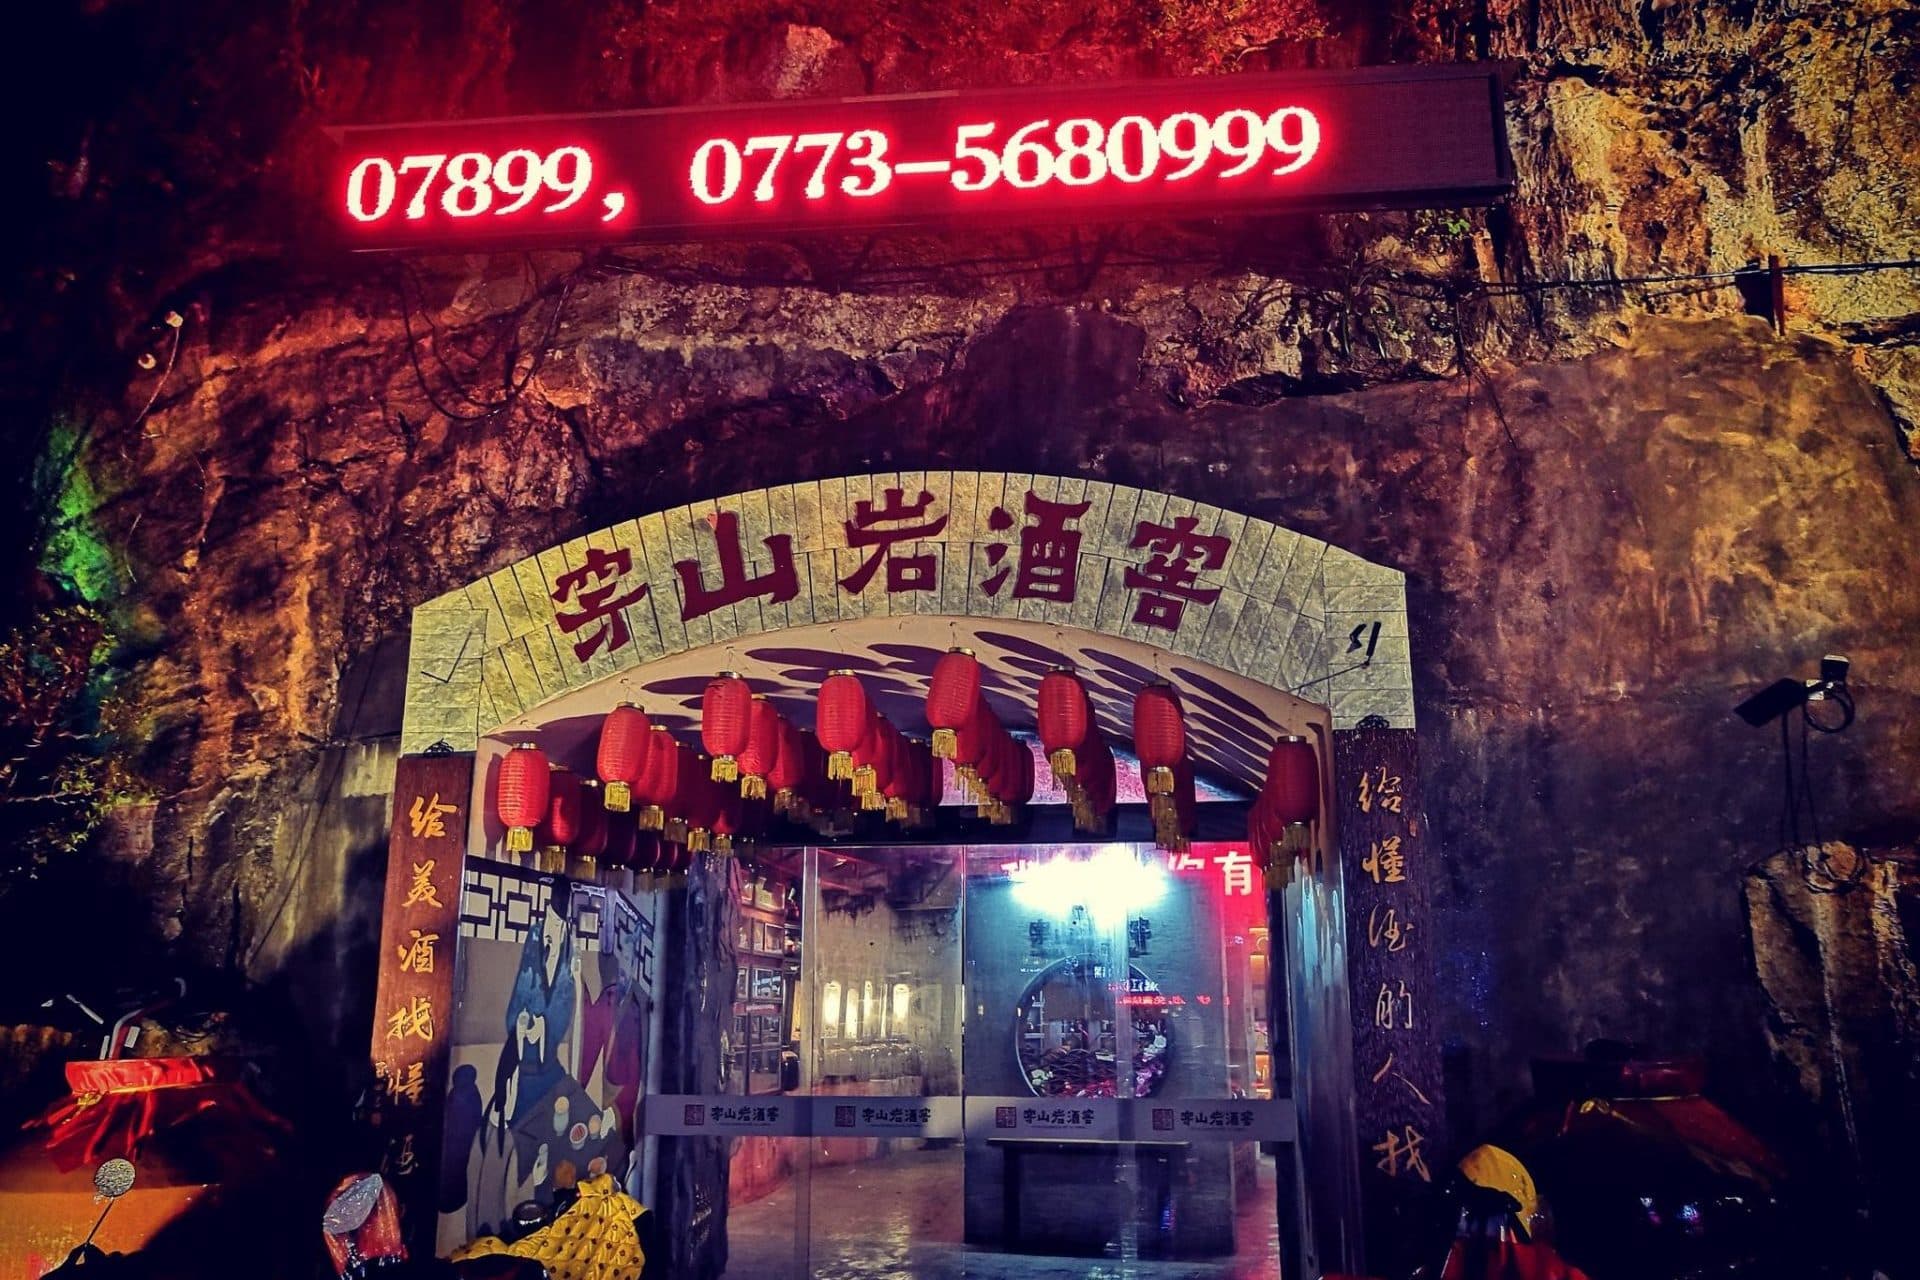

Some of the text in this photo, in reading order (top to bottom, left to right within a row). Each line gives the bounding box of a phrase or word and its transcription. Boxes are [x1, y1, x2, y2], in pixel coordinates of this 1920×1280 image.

[551, 486, 1232, 663] 穿山岩酒窖
